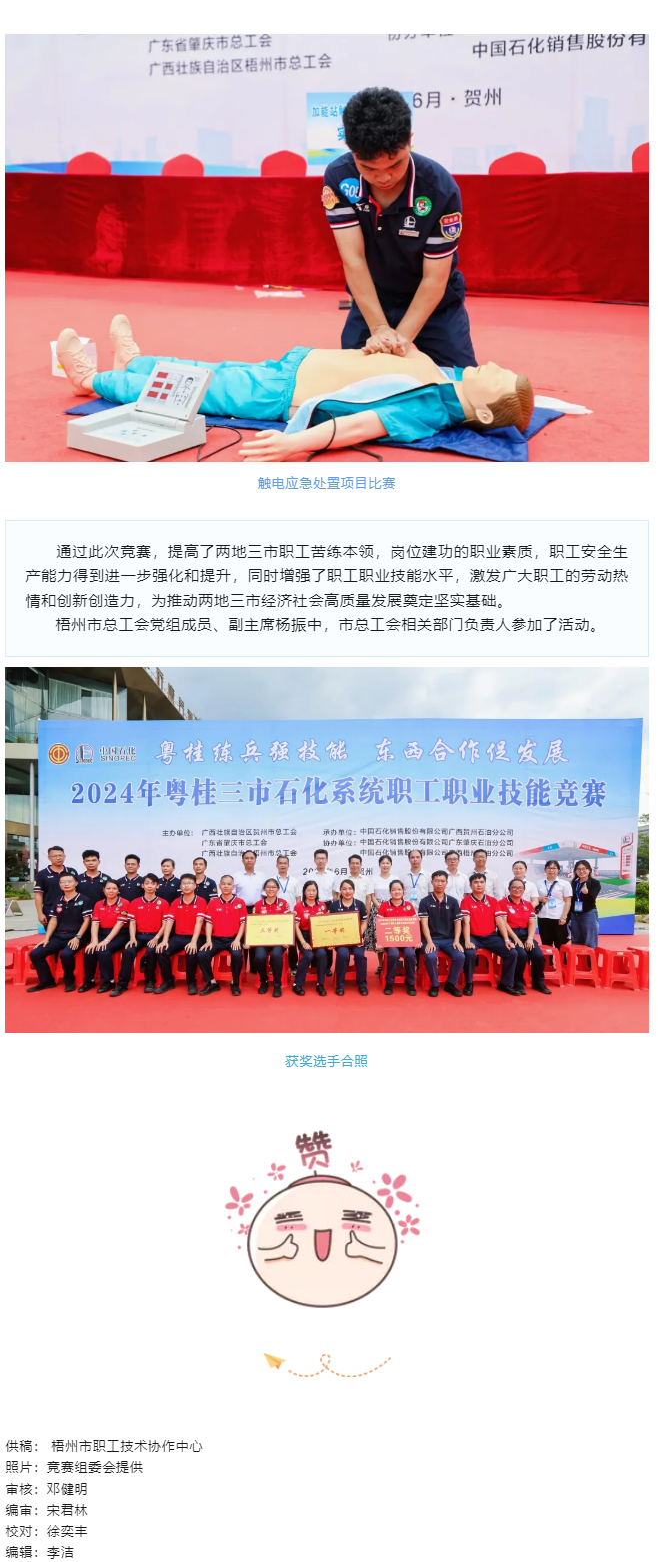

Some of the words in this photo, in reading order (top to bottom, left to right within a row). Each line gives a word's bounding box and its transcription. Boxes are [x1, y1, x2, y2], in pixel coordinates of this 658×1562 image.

[148, 34, 272, 53] 广东省肇庆市总工会
[149, 53, 332, 76] 广西壮族自治区梧州市总工会
[99, 746, 137, 756] 中国石化
[155, 737, 348, 765] 粤桂练兵强技能
[375, 738, 570, 765] 东西合作促发展
[100, 755, 137, 763] SINOPEC
[70, 775, 607, 808] 2024年粤桂三市石化系统职工职业技能竞赛
[384, 926, 411, 935] 二等奖
[384, 934, 414, 942] 1500元
